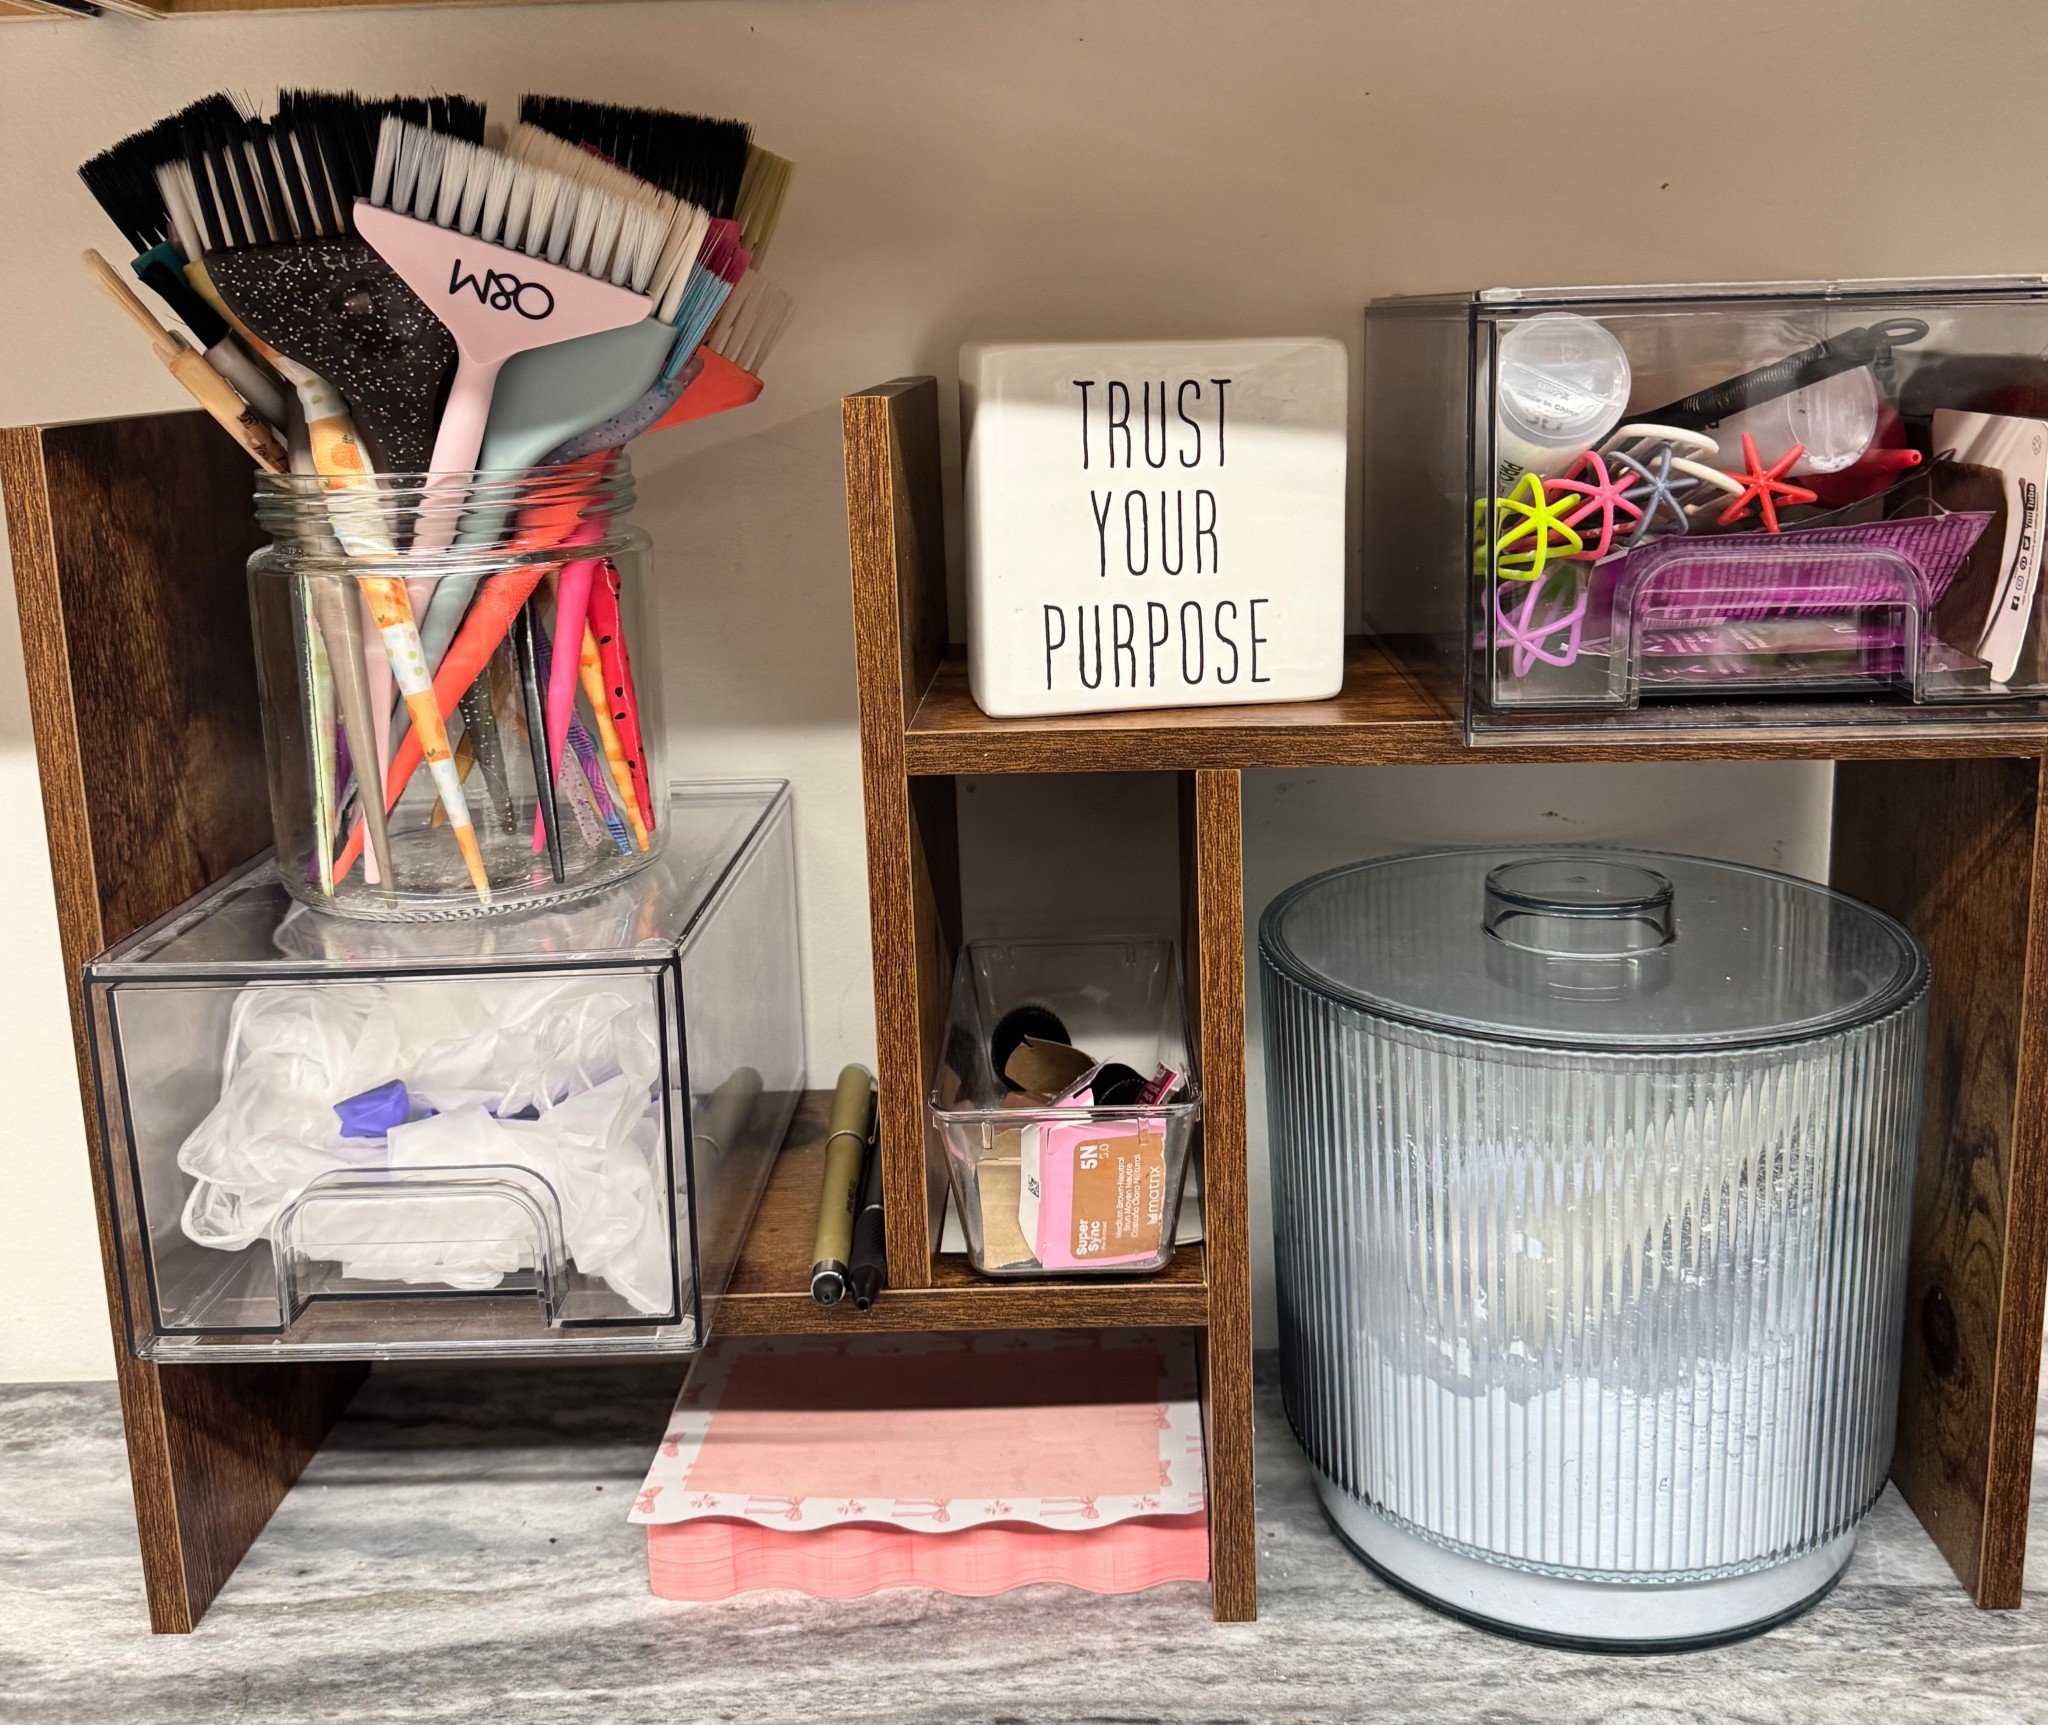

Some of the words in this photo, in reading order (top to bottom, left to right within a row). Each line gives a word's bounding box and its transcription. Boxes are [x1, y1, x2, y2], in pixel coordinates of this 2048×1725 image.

[269, 249, 379, 275] TRIX
[449, 258, 555, 320] O&M
[1072, 378, 1232, 470] TRUST
[1090, 489, 1219, 577] YOUR
[1043, 598, 1271, 690] PURPOSE
[1080, 1145, 1098, 1170] 5N
[1133, 1154, 1141, 1184] Ntural
[1148, 1166, 1161, 1213] matrix
[1076, 1218, 1091, 1255] Super
[1088, 1220, 1102, 1251] Sync
